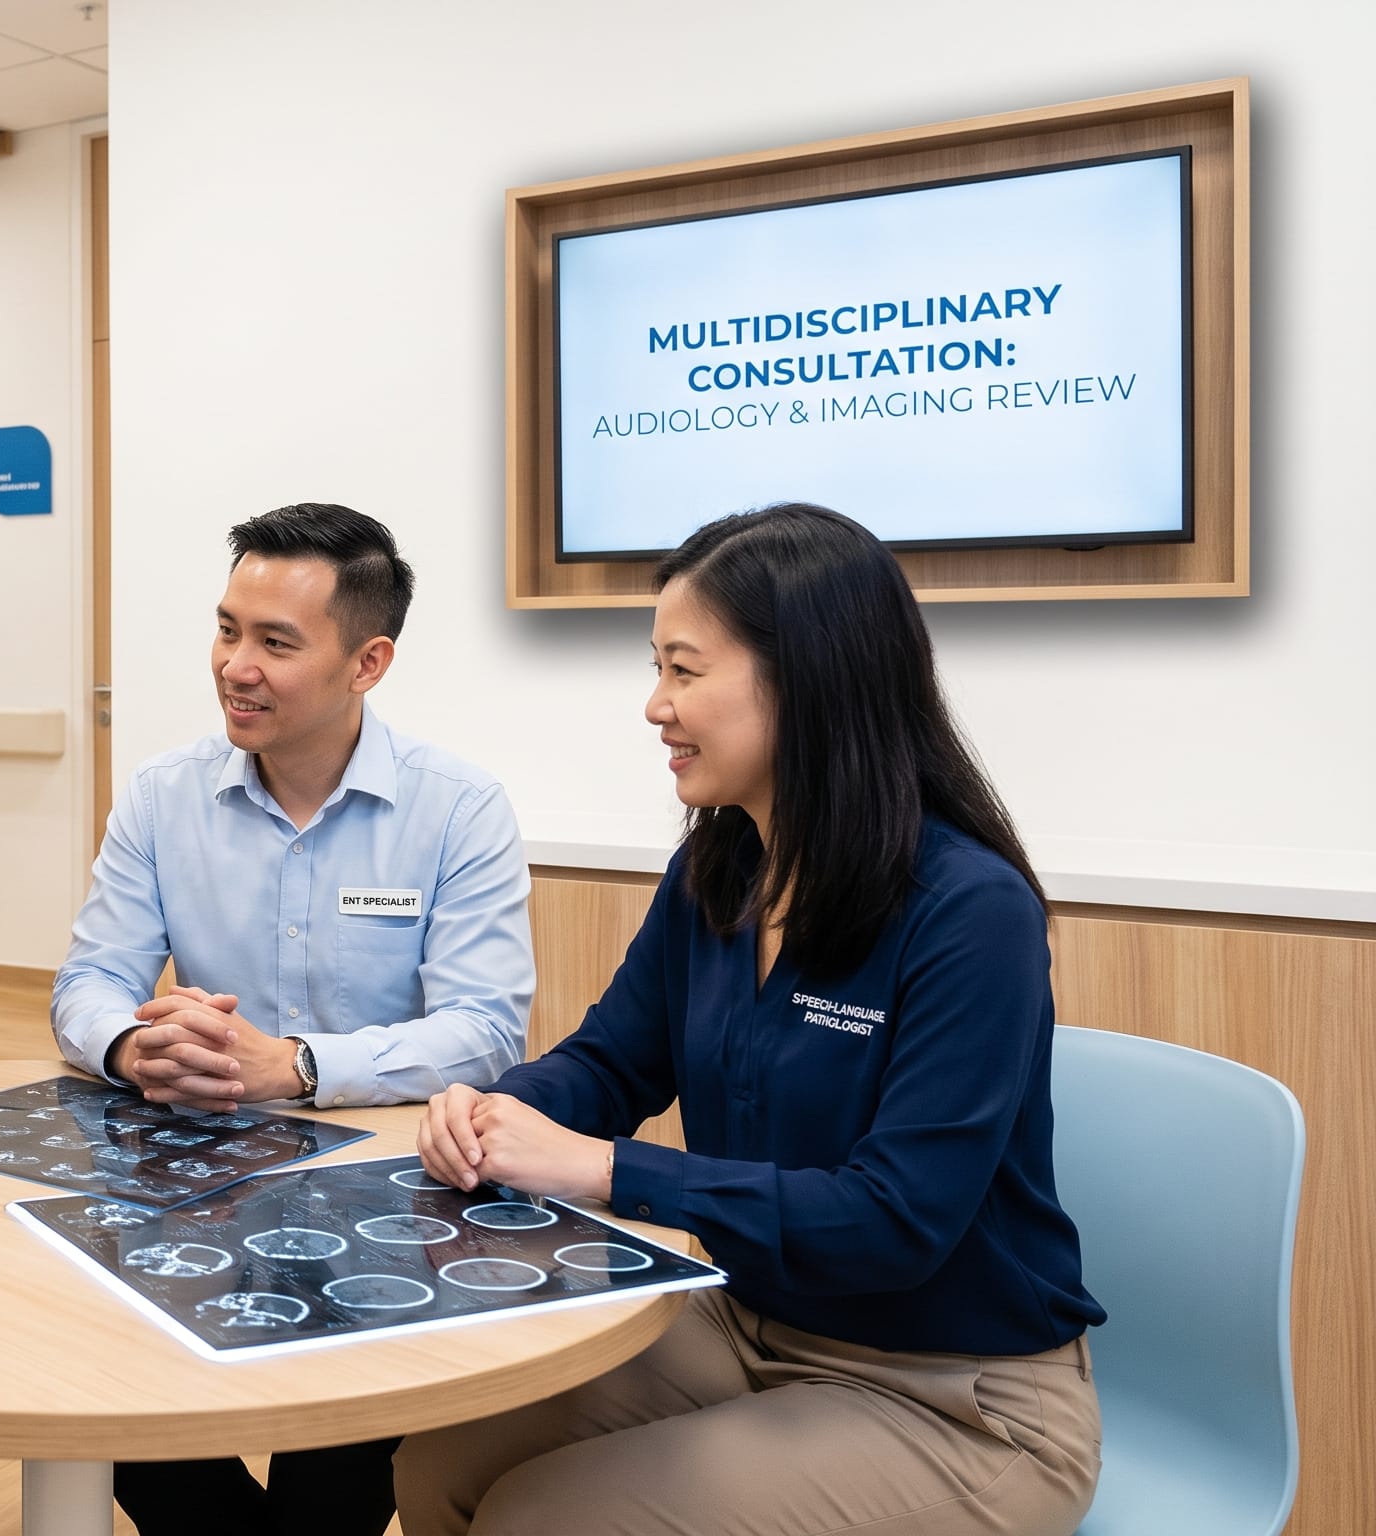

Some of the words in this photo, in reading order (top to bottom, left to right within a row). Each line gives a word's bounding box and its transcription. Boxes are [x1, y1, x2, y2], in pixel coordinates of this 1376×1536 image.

[649, 284, 1062, 353] MULTIDISCIPLINARY
[688, 338, 1016, 392] CONSULTATION:
[593, 402, 780, 438] AUDIOLOGY
[789, 400, 809, 424] &
[821, 387, 973, 422] IMAGING
[988, 374, 1136, 410] REVIEW
[343, 896, 361, 905] ENT
[363, 897, 417, 906] SPECIALIST
